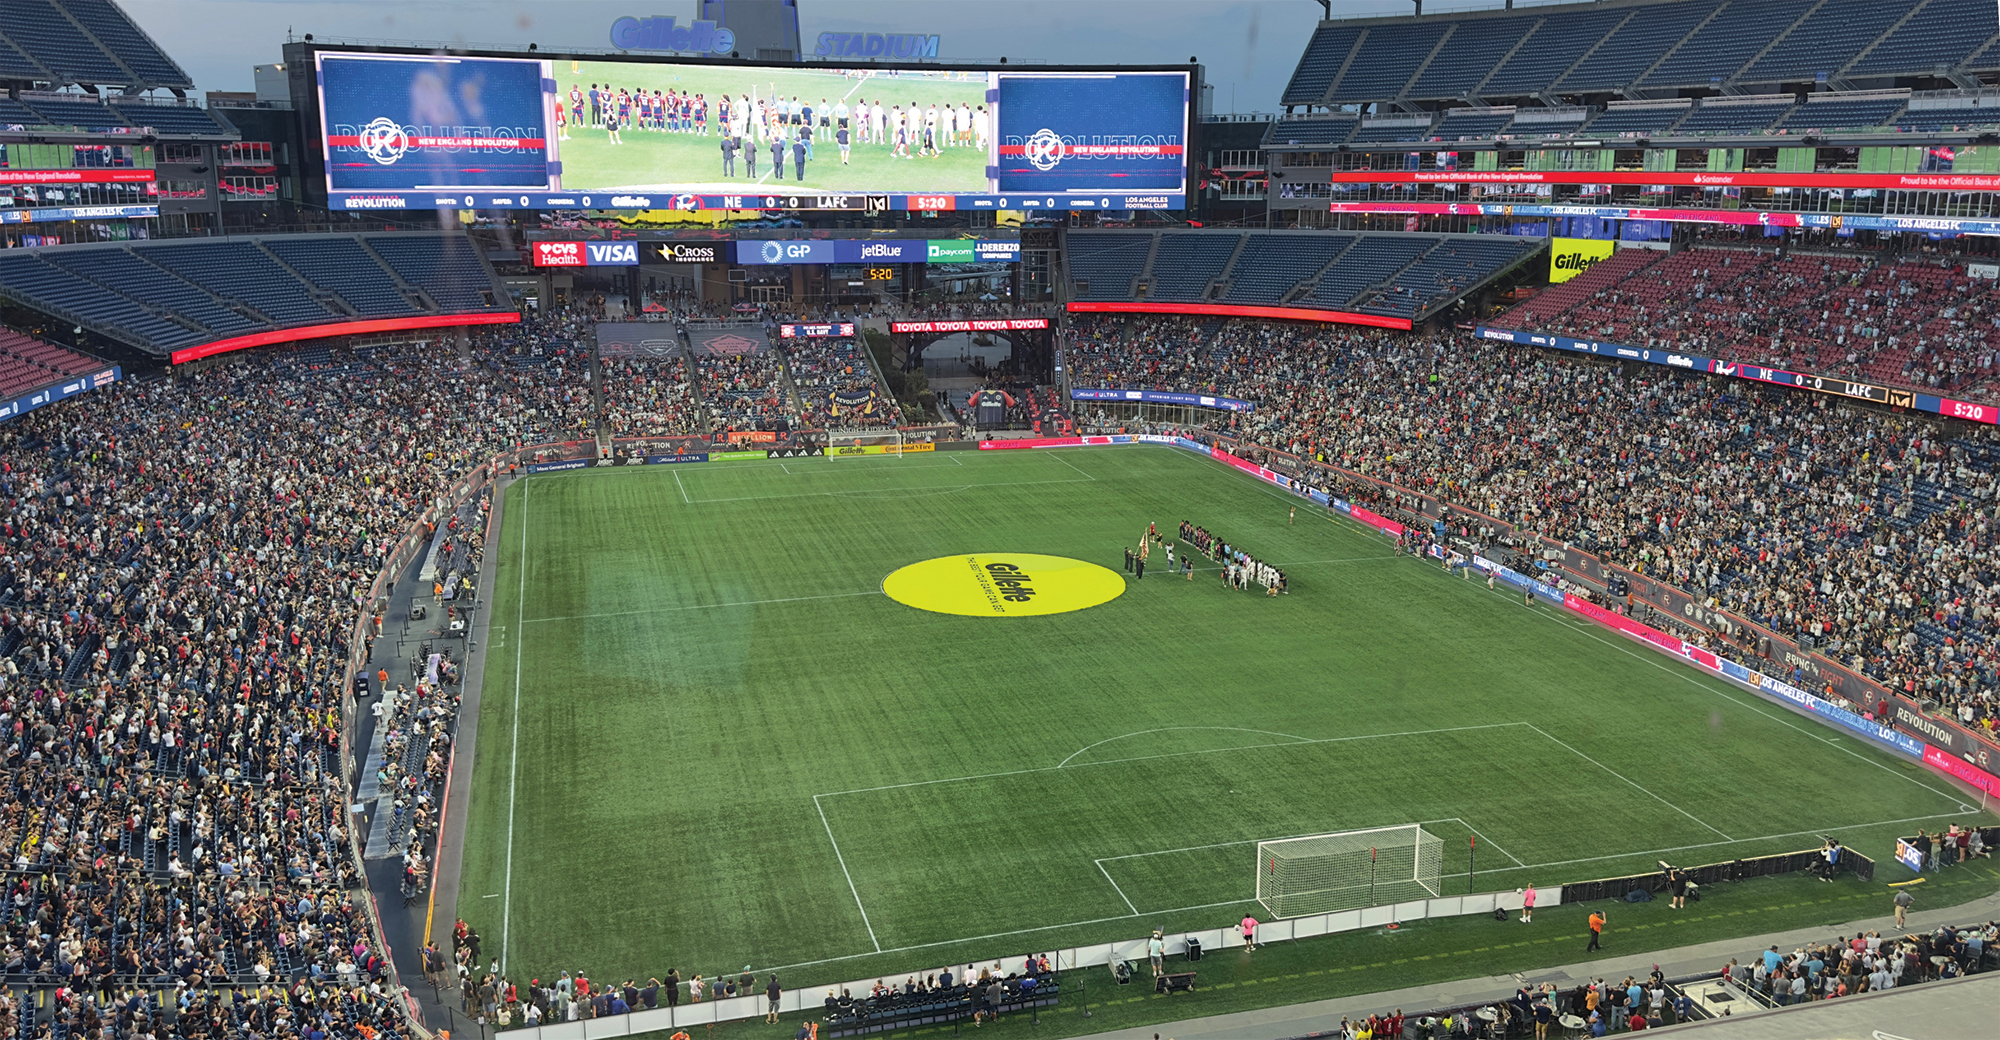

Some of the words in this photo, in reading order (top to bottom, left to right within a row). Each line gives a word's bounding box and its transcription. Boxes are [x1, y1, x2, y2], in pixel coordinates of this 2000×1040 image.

[611, 16, 736, 54] Gillette
[816, 32, 940, 58] STADIUM
[473, 139, 519, 147] REVOLUTION
[36, 172, 55, 181] England
[345, 199, 406, 208] REVOLUTION
[465, 196, 474, 207] 0
[520, 196, 529, 207] 0
[582, 196, 591, 207] 0
[611, 196, 650, 207] Gillette
[724, 196, 742, 208] NE
[767, 197, 774, 207] 0
[790, 197, 798, 208] 0
[817, 197, 848, 208] LAFC
[918, 197, 946, 208] 5:20
[999, 198, 1007, 208] 0
[1047, 198, 1054, 208] 0
[1101, 198, 1109, 208] 0
[87, 208, 115, 216] ANGELES
[1898, 220, 1913, 228] LOS
[1914, 220, 1950, 230] ANGELES
[1950, 222, 1960, 230] FC
[552, 244, 578, 254] CVS
[588, 245, 636, 262] VISA
[674, 244, 714, 257] CROSS
[787, 245, 810, 257] GP
[861, 244, 901, 259] jetBlue
[542, 255, 578, 264] Health
[1555, 253, 1600, 270] Gillett
[870, 269, 892, 280] 5:20
[897, 323, 932, 332] TOYOTA
[935, 322, 970, 331] TOYOTA
[973, 321, 1008, 330] TOYOTA
[1010, 320, 1044, 329] TOYOTA
[1484, 330, 1514, 341] REVOLUTION
[1549, 337, 1555, 346] 0
[1592, 342, 1597, 352] 0
[1643, 350, 1649, 360] 0
[1667, 355, 1693, 368] Gillette
[1760, 368, 1772, 381] NE
[1796, 375, 1803, 386] 0
[1815, 378, 1822, 389] 0
[1845, 383, 1872, 398] LAFC
[836, 395, 870, 405] REVOLUTION
[1954, 403, 1982, 419] 5:20
[566, 462, 585, 470] Brigham
[985, 563, 1036, 602] Gillette
[1786, 651, 1810, 672] BRING
[1820, 668, 1844, 687] FIGHT
[1773, 682, 1805, 703] ANGELES
[1805, 694, 1816, 708] FC
[1896, 706, 1952, 746] REVOLUTION
[1879, 726, 1895, 742] LOS
[1954, 764, 1993, 792] ENGLAND
